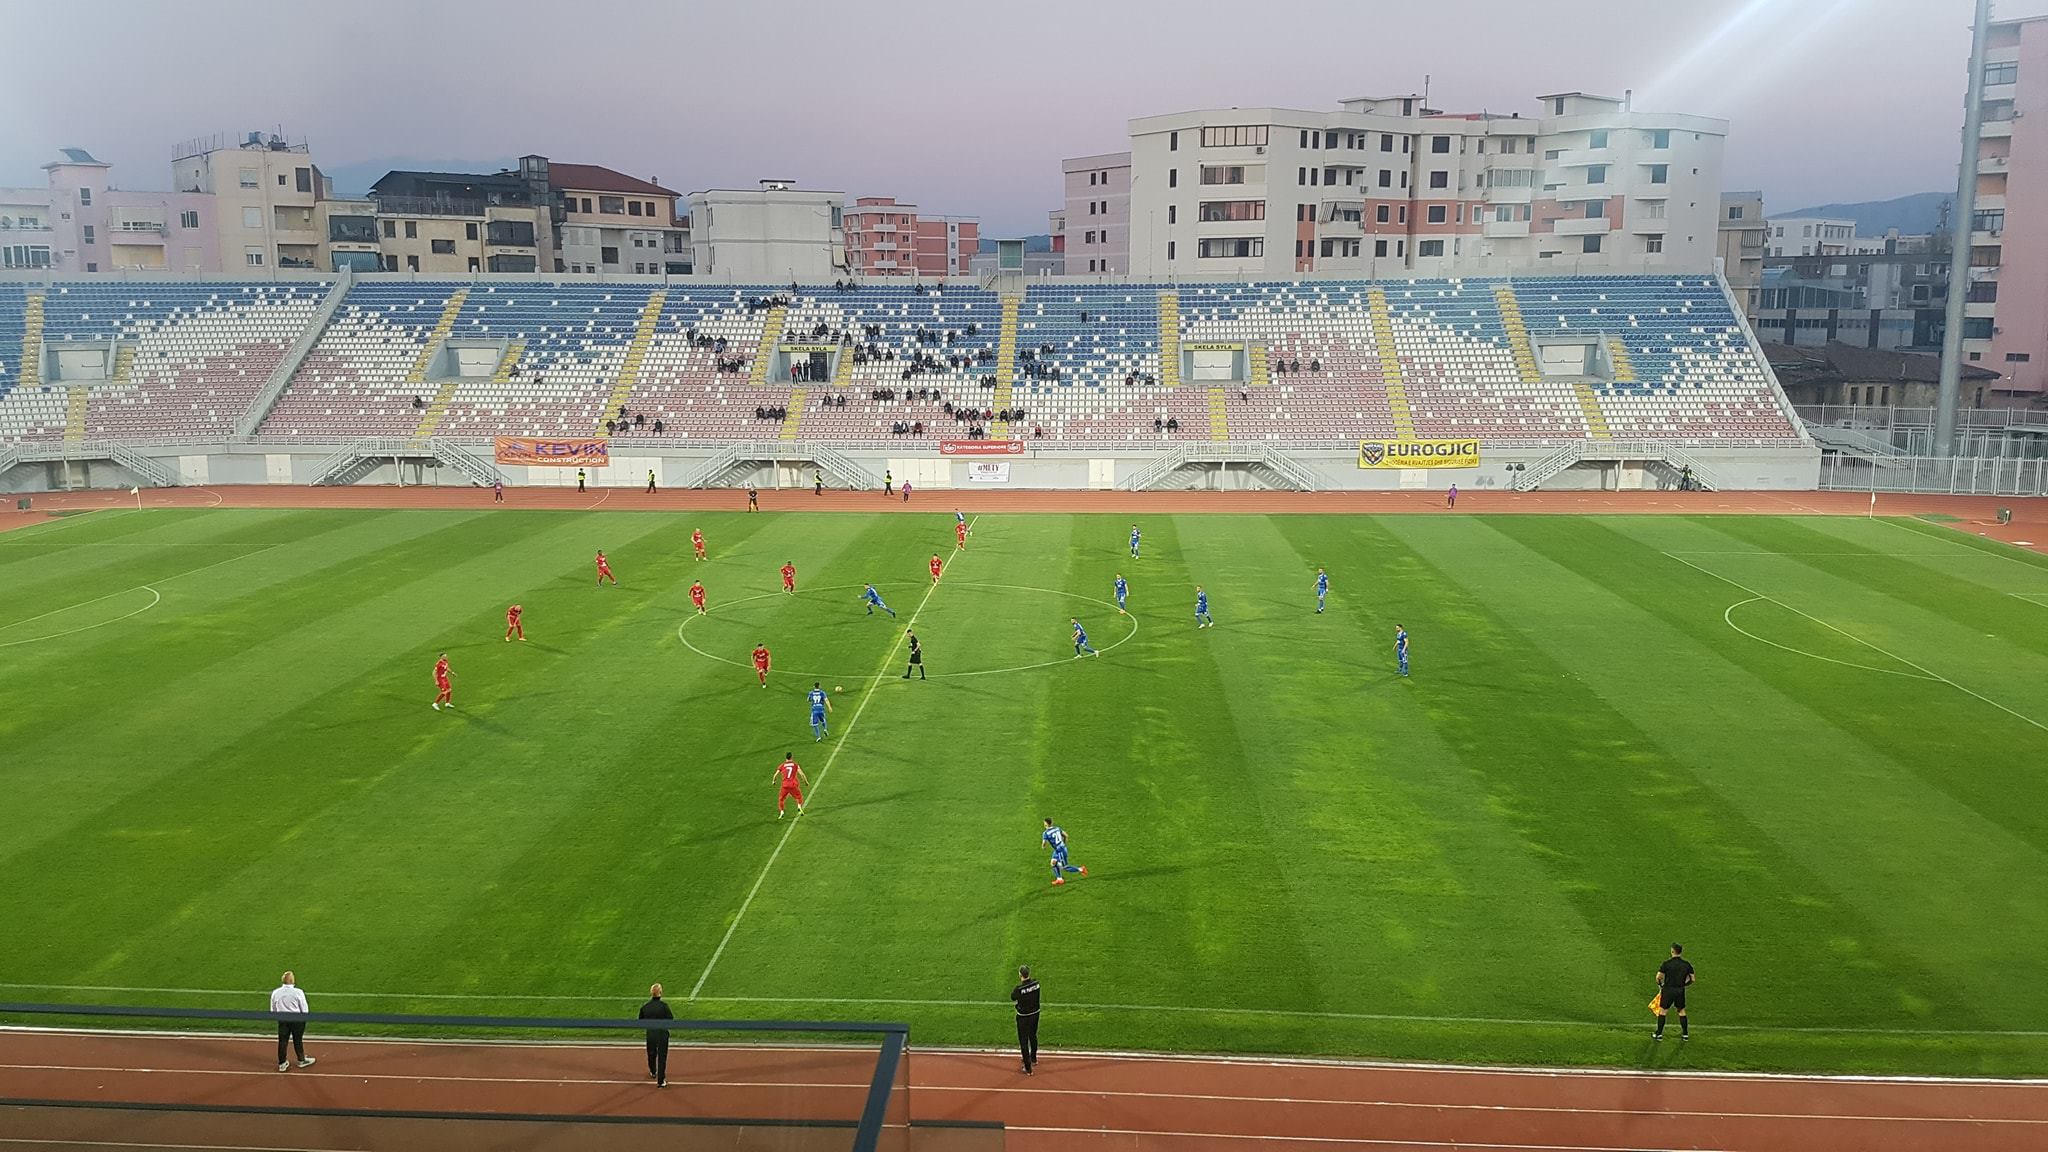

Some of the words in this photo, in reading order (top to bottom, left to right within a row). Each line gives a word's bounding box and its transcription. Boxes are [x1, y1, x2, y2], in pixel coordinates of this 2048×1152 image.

[535, 442, 608, 456] KEVIN
[1387, 442, 1478, 457] EUROGJICI
[537, 456, 605, 464] CONSTRUCTION
[812, 695, 822, 704] 99
[785, 766, 793, 779] 7
